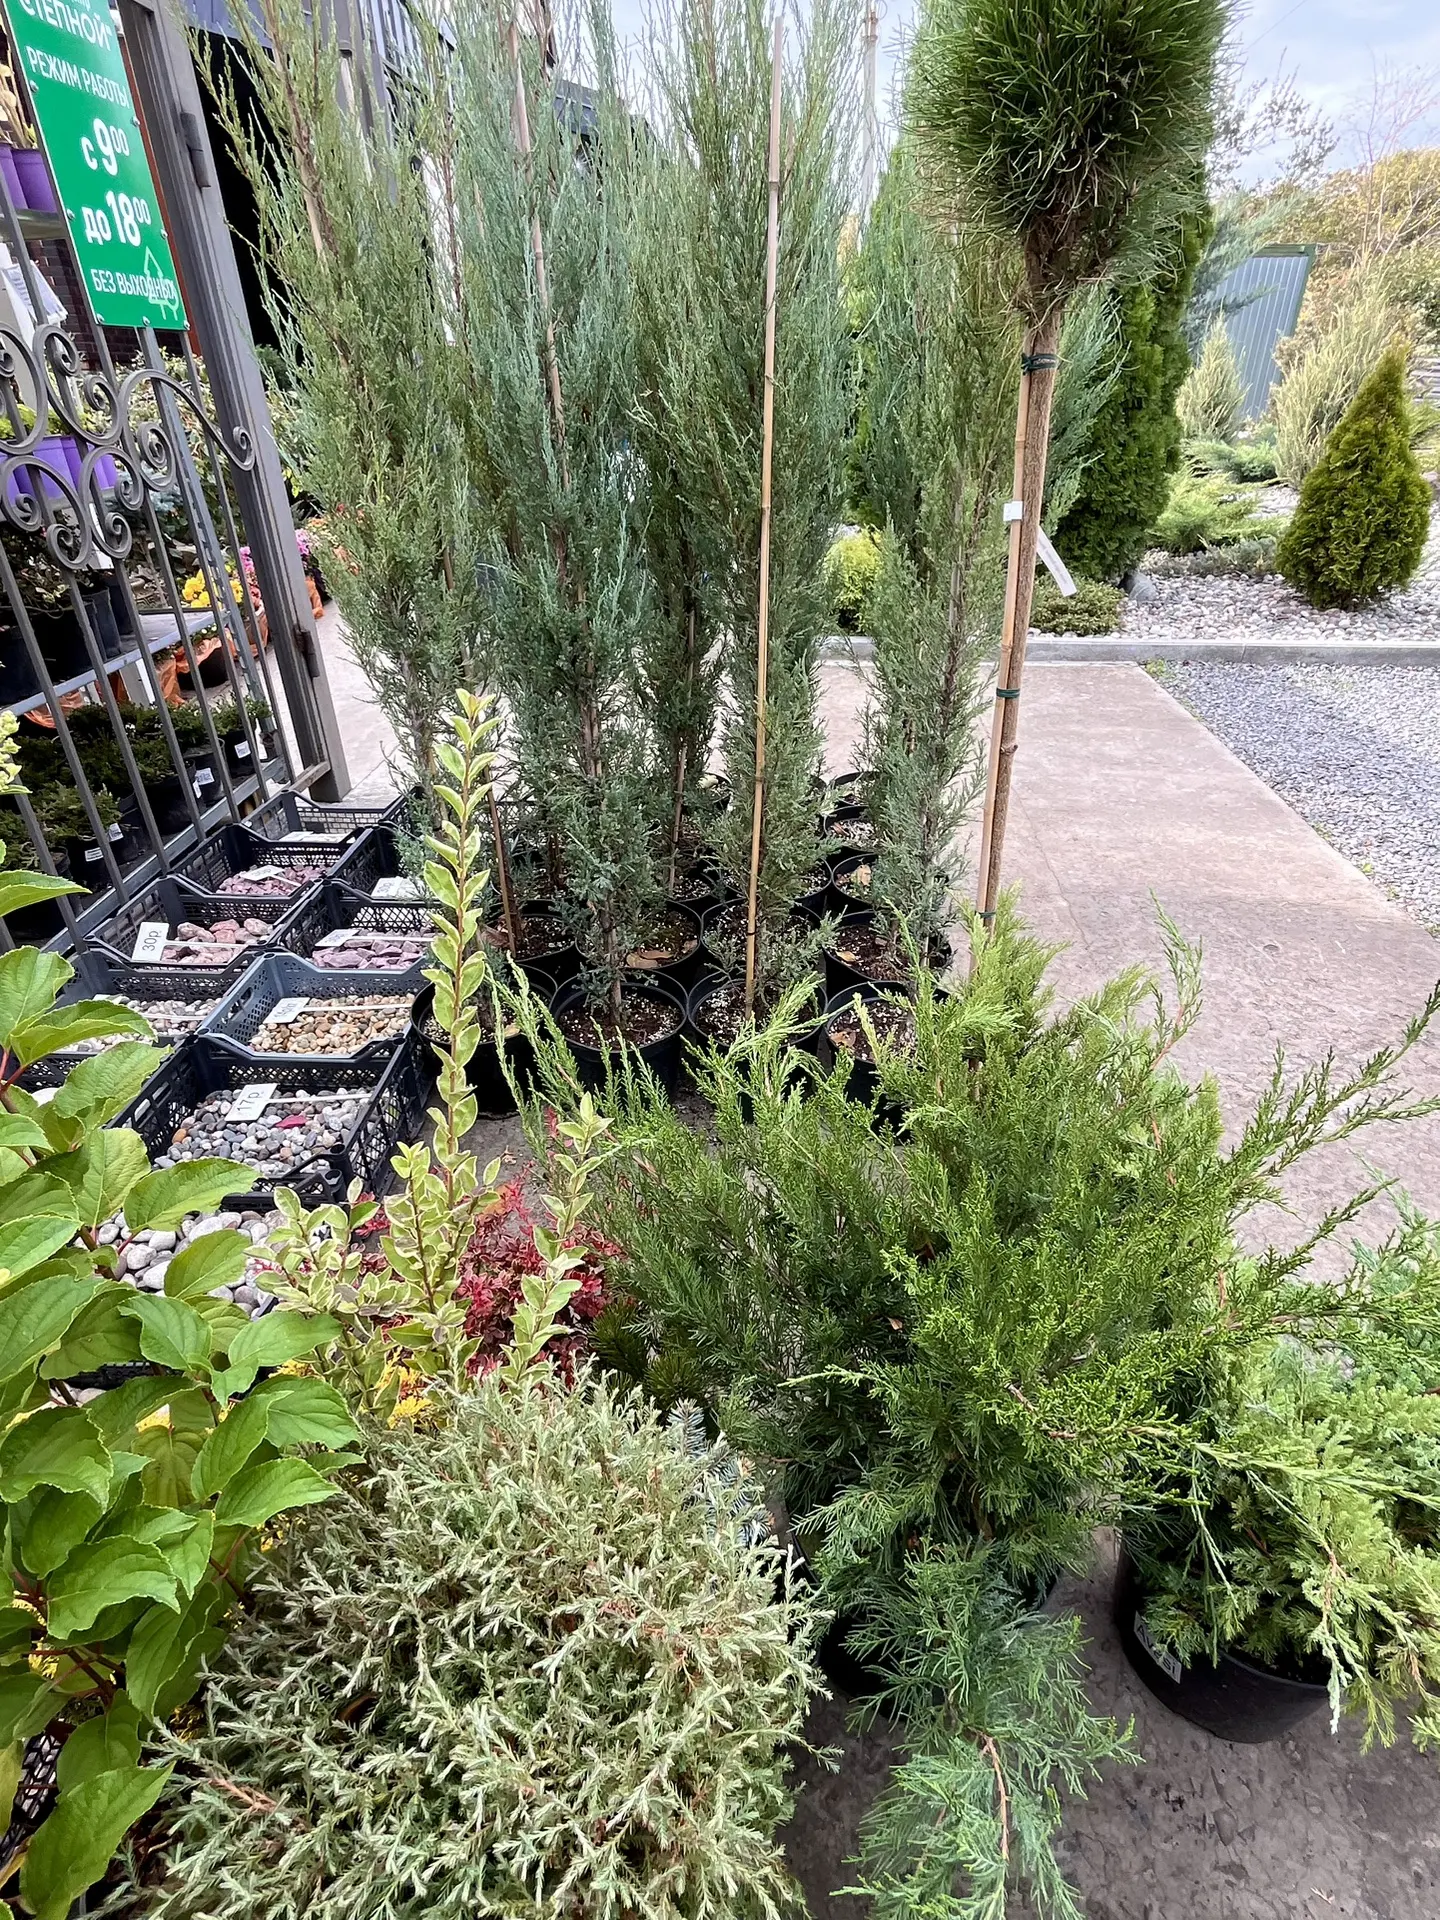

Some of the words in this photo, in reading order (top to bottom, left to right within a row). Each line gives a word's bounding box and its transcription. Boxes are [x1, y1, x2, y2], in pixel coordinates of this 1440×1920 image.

[25, 45, 82, 90] РЕЖИМ
[80, 67, 130, 109] РАБОТЫ
[81, 206, 112, 246] до
[91, 268, 117, 294] БЕЗ
[116, 272, 176, 300] ВЫХОДНЫХ
